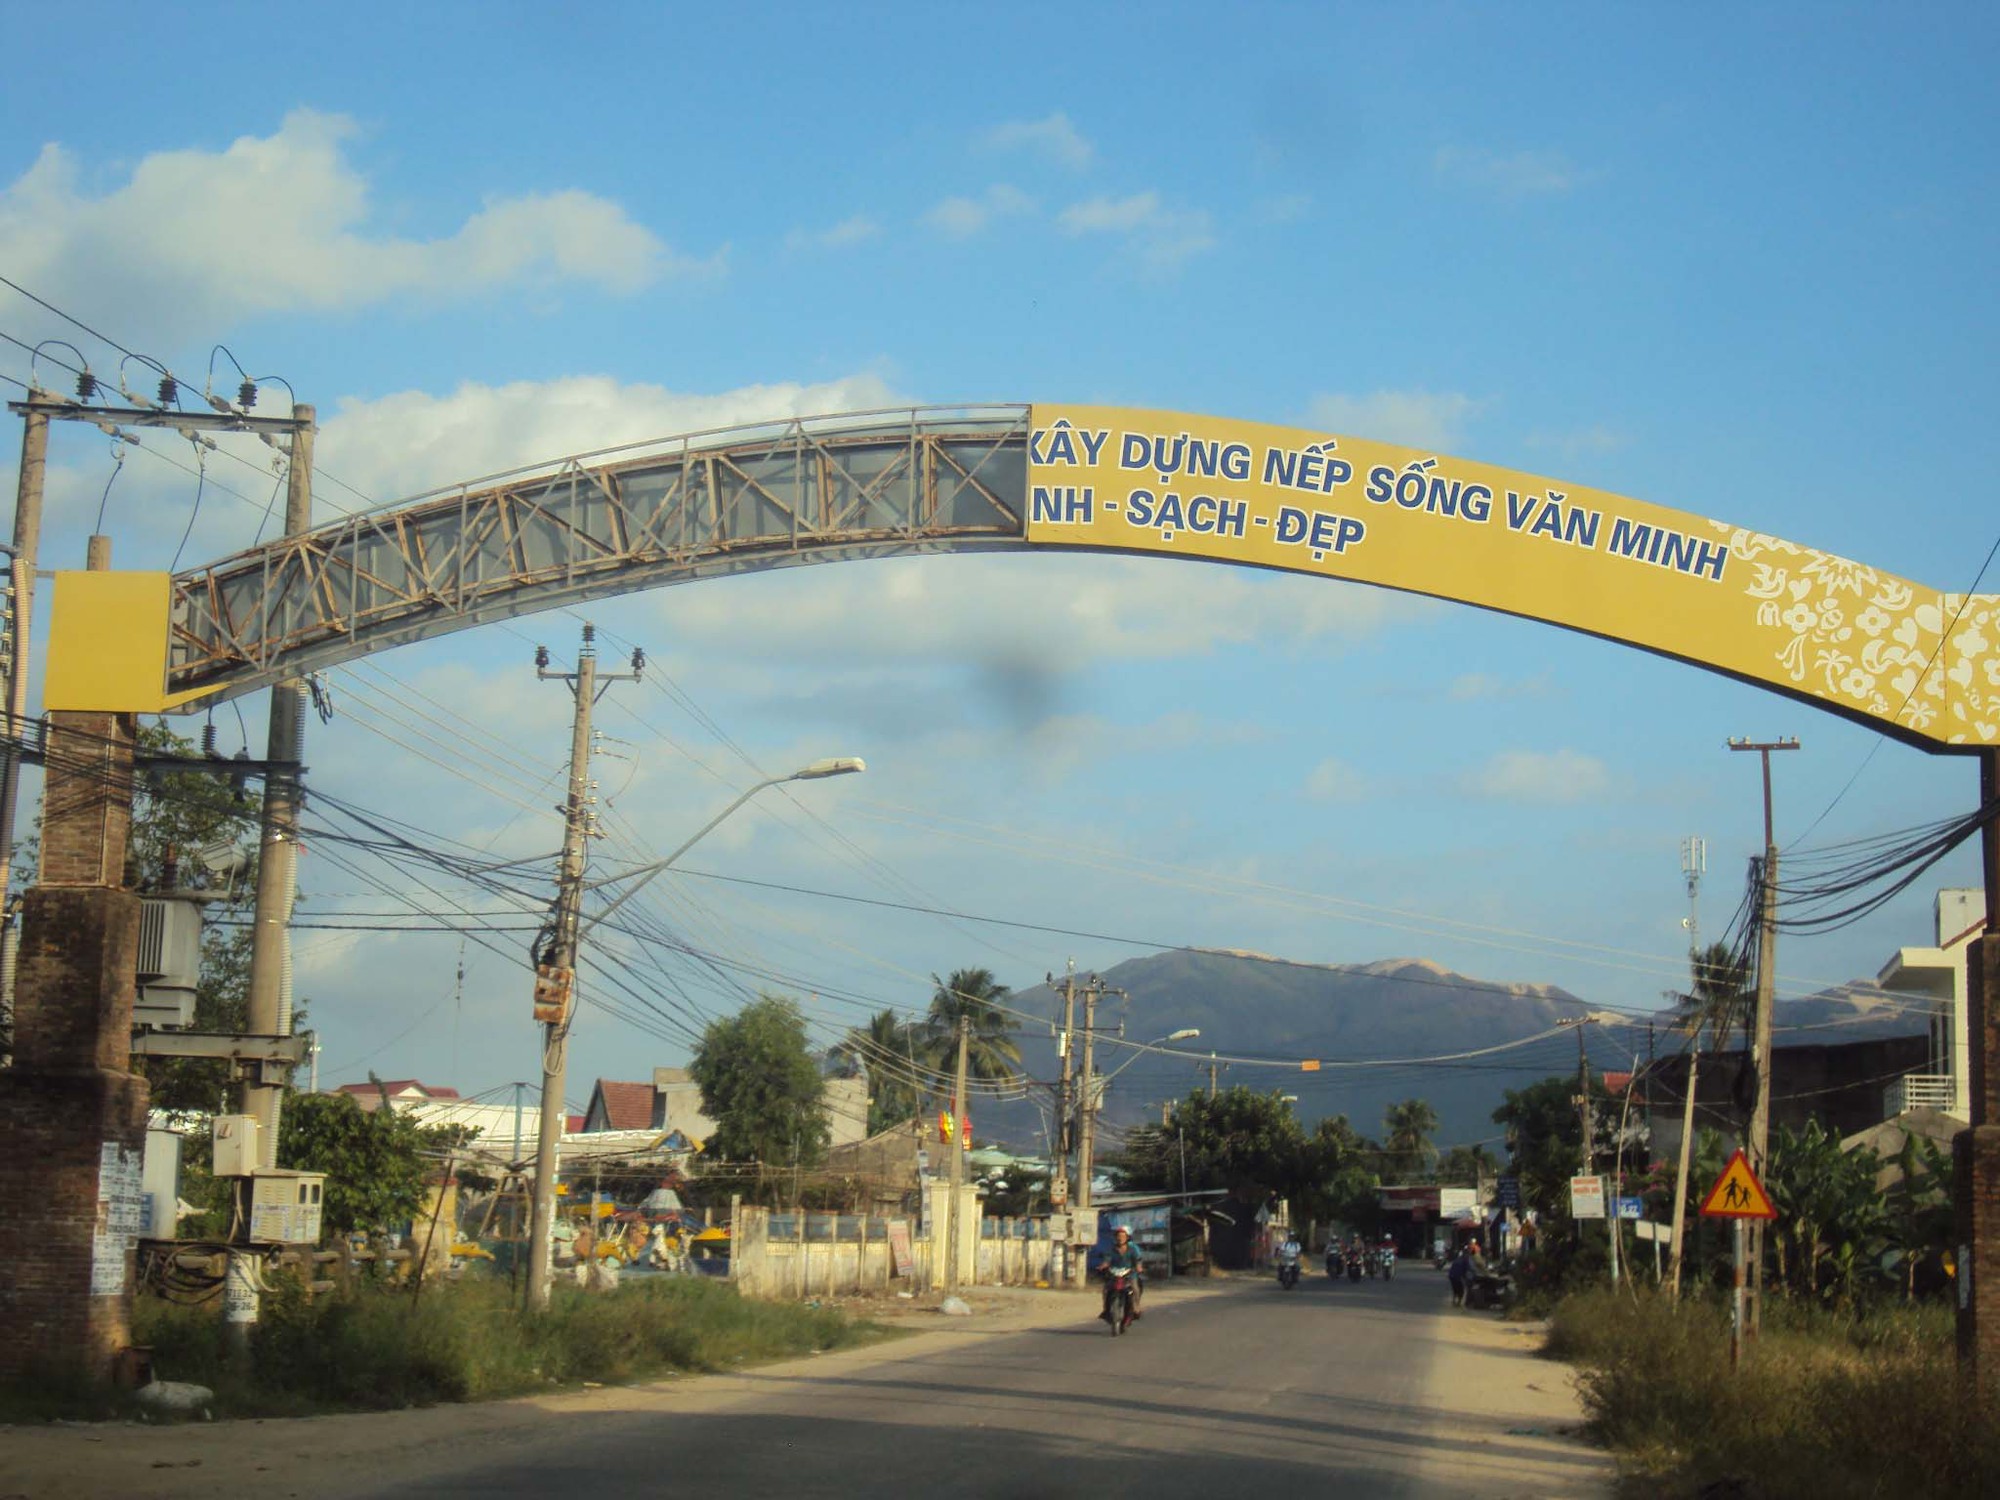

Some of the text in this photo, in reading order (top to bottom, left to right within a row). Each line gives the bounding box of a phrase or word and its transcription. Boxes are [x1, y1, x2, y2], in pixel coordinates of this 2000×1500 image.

[1121, 433, 1251, 484] DỰNG
[1264, 439, 1352, 495] NẾP
[1366, 457, 1492, 522] SỐNG
[1507, 490, 1601, 548] VĂN
[1608, 517, 1729, 582] MINH
[1126, 489, 1246, 541] SẠCH
[1277, 506, 1366, 561] ĐẸP
